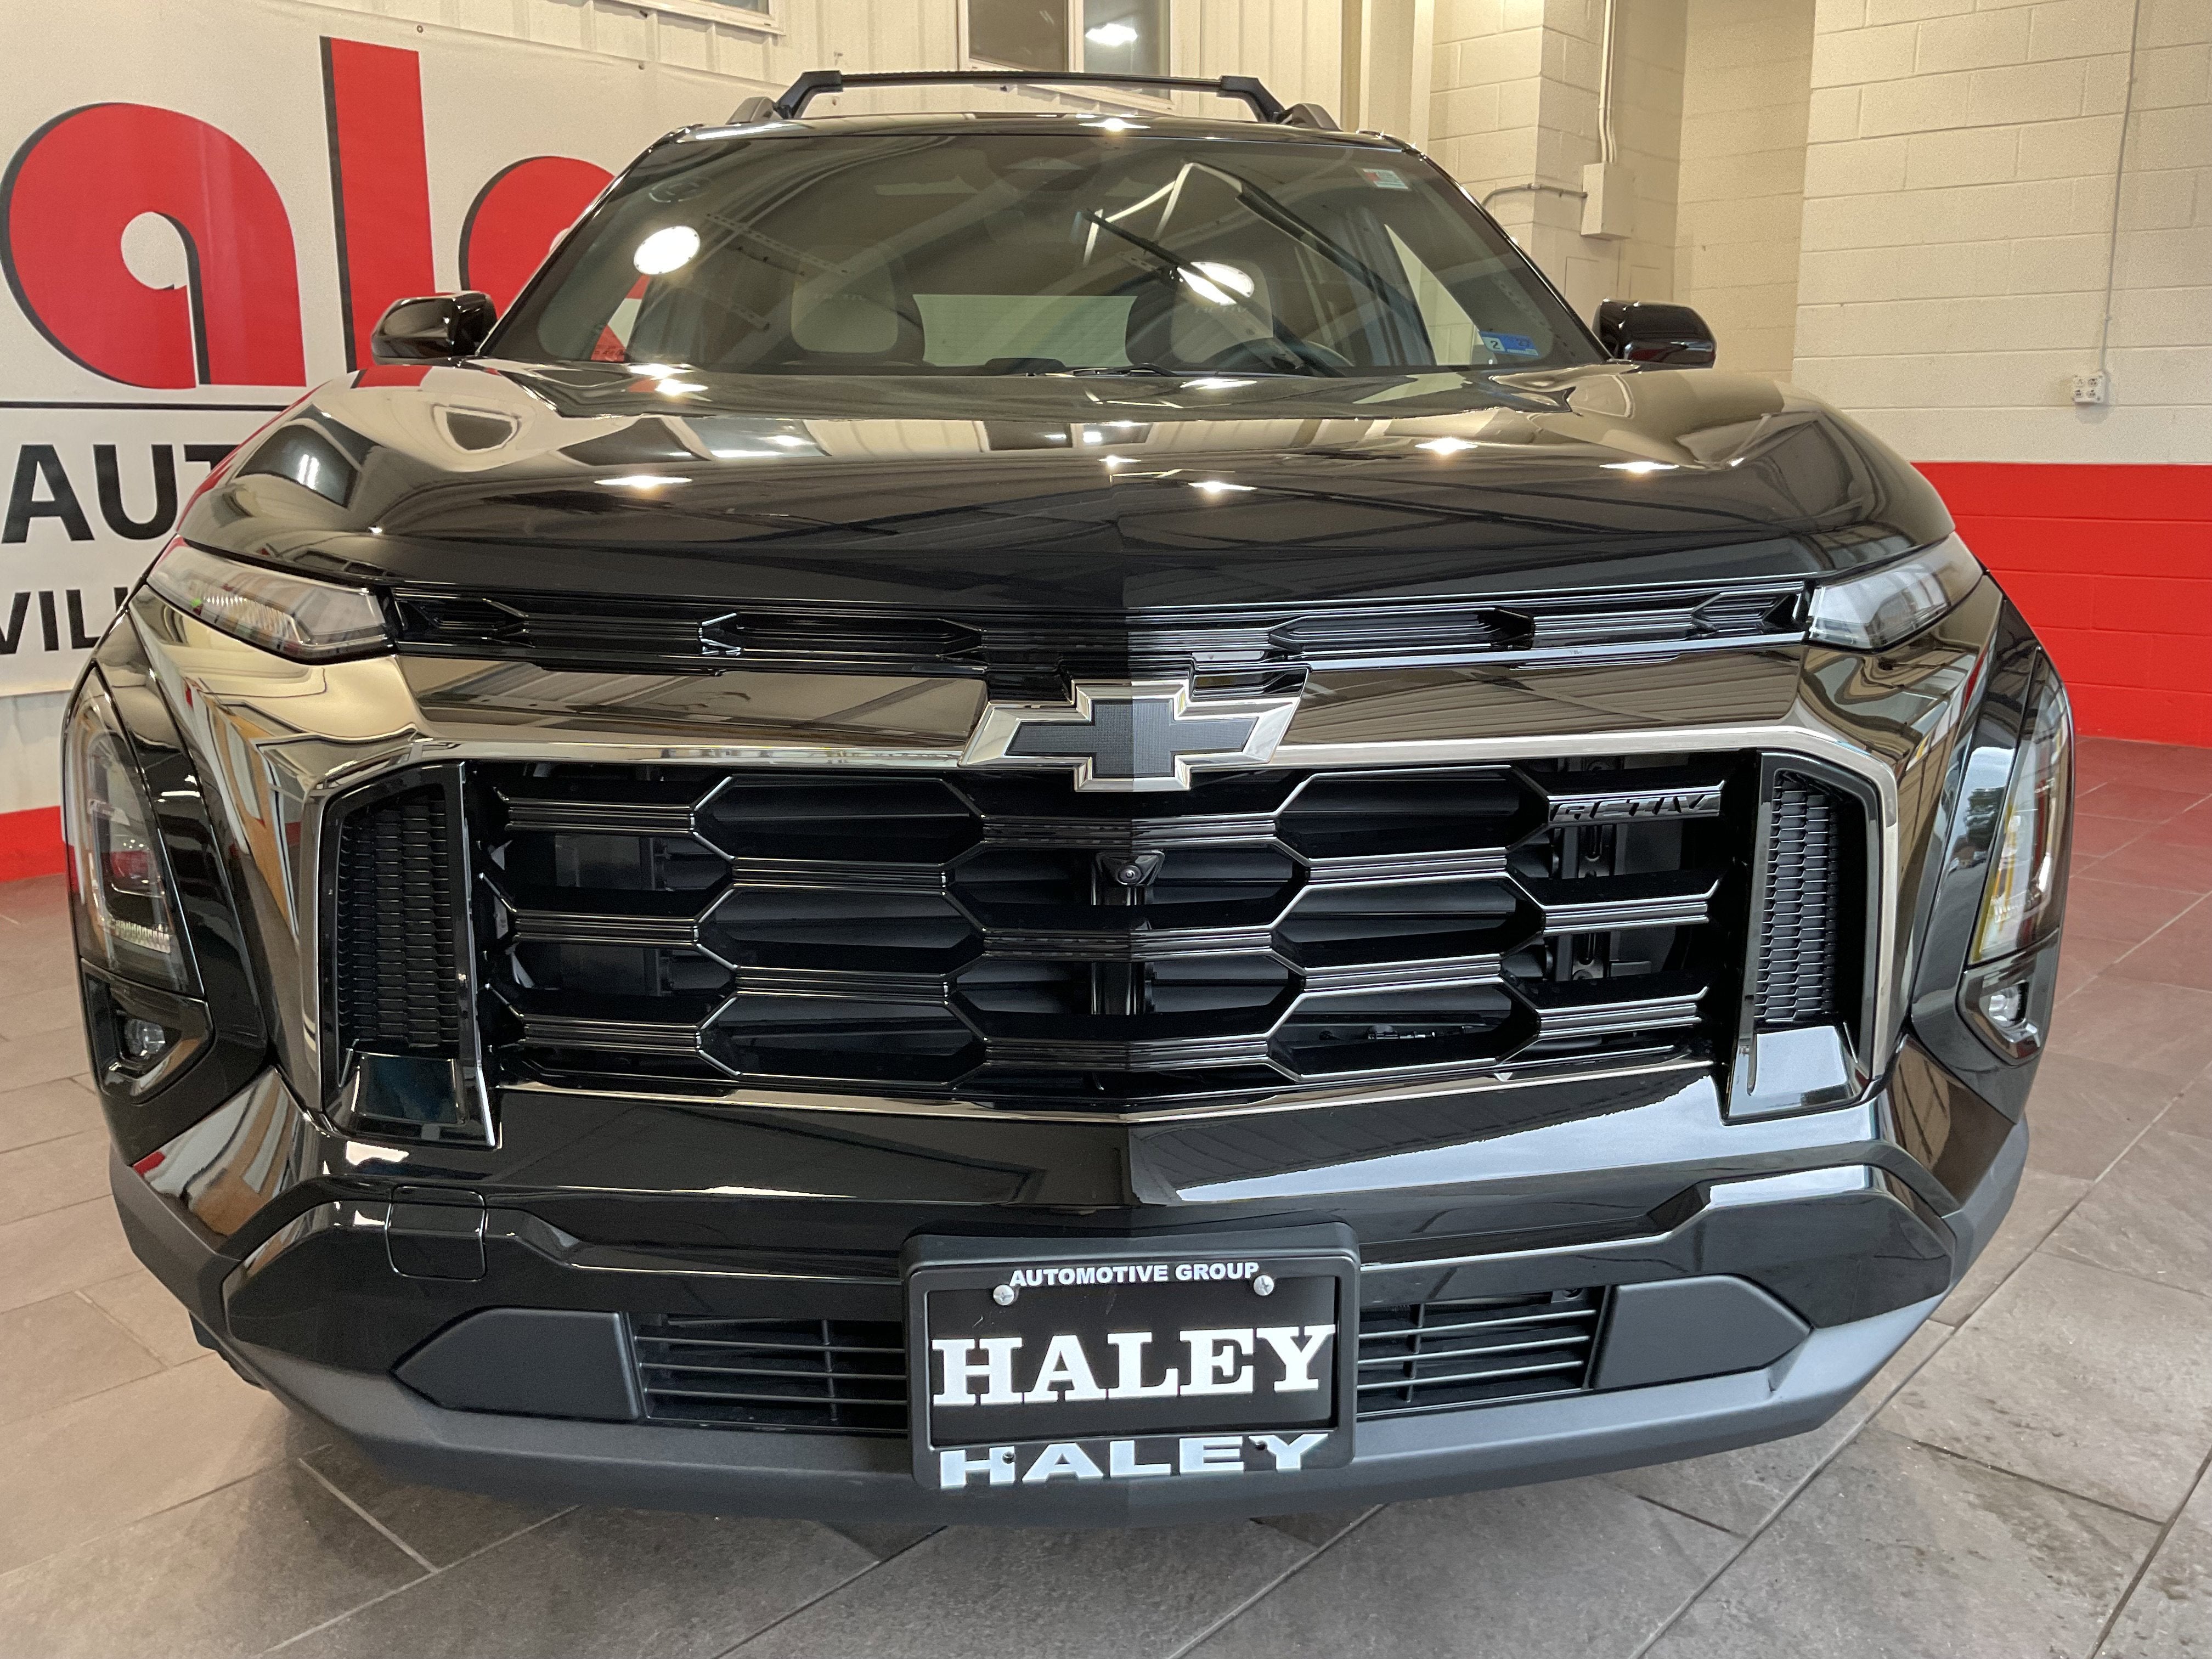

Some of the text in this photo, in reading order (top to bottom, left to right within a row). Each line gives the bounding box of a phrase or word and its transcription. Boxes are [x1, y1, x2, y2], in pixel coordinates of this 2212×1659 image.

[1490, 340, 1500, 349] 2
[1551, 794, 1721, 821] ACTIV
[1009, 1262, 1260, 1287] AUTOMOTIVE GROUP
[932, 1324, 1337, 1406] HALEY
[940, 1432, 1329, 1489] HALEY
